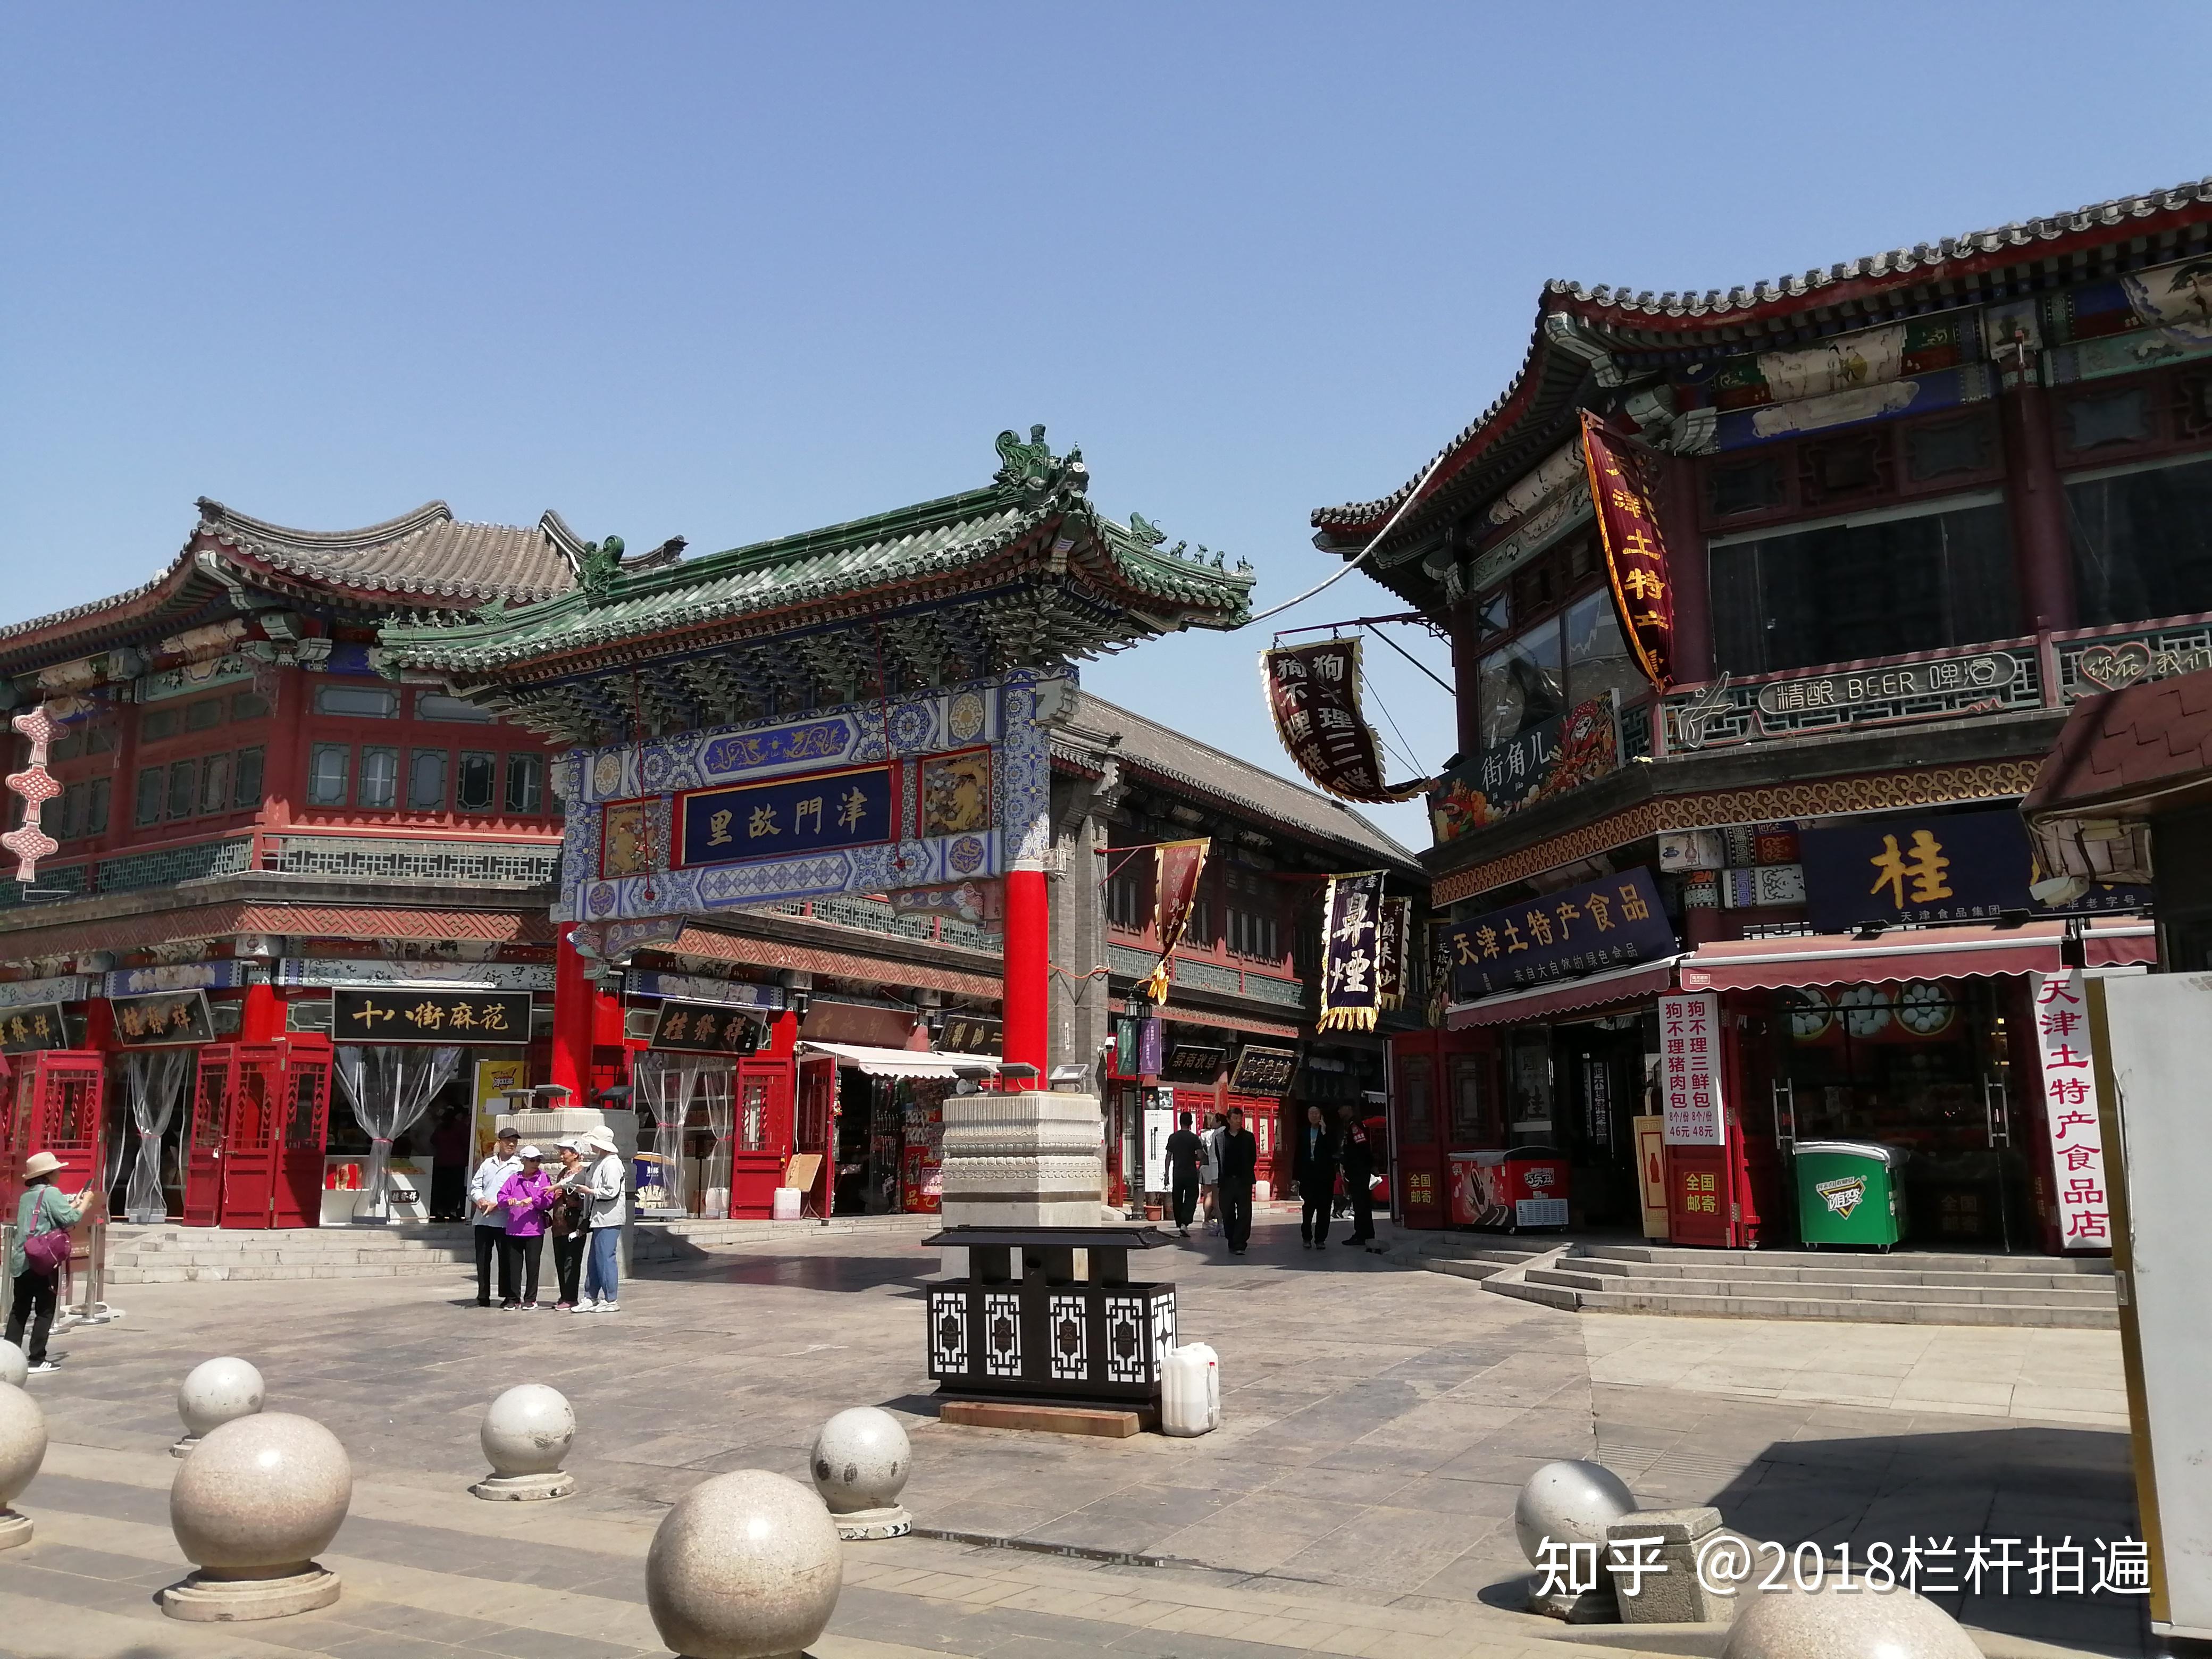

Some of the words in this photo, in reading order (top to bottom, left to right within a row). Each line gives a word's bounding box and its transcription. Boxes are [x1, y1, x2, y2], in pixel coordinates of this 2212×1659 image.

[1777, 679, 1834, 709] 精酿
[1848, 672, 1914, 699] BEER
[1481, 731, 1551, 791] 街角儿
[2051, 894, 2136, 911] 华老字号
[1900, 904, 2001, 923] 天津食品集团
[1453, 883, 1650, 966] 天津土特产食品
[1514, 942, 1638, 982] 来自大自然的绿色食品
[353, 1000, 509, 1030] 十八街麻花
[1665, 1002, 1687, 1108] 狗不理猪肉包
[1688, 1001, 1711, 1108] 狗不理三鲜包
[1669, 1111, 1689, 1123] 8个/份
[1692, 1110, 1712, 1123] 8个/份
[2037, 979, 2109, 1239] 天津土特产食品店
[1670, 1126, 1690, 1137] 46元
[1693, 1125, 1713, 1138] 48元
[1410, 1174, 1431, 1188] 全国
[1686, 1173, 1714, 1192] 全国
[1410, 1189, 1432, 1204] 邮寄
[1687, 1194, 1715, 1213] 邮寄
